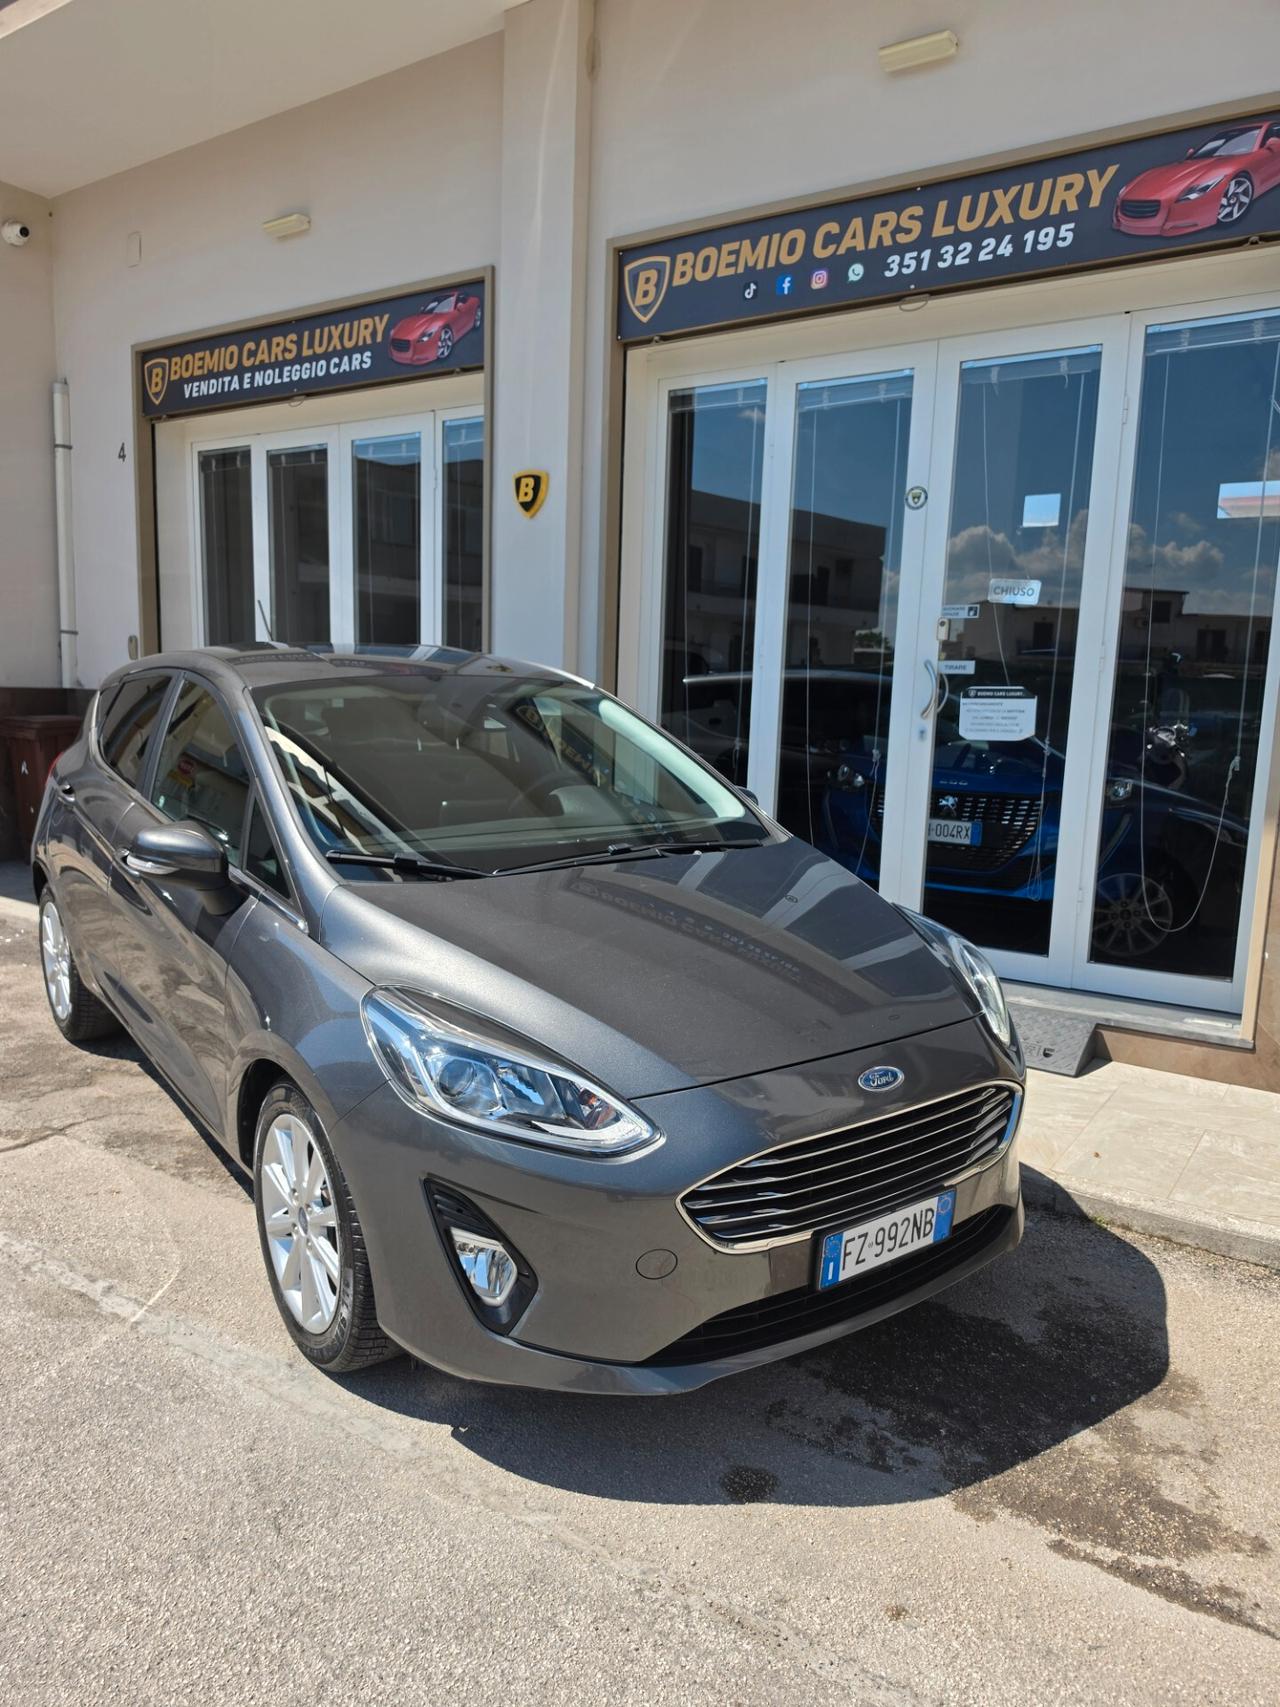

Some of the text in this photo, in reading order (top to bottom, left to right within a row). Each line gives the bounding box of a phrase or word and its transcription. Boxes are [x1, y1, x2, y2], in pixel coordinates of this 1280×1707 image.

[672, 163, 1120, 287] BOEMIO CARS LUXURY
[883, 222, 1075, 278] 351 32 24 195
[634, 268, 659, 307] B
[170, 313, 390, 381] BOEMIO CARS LUXURY
[150, 367, 163, 394] B
[183, 351, 372, 399] VENDITA E NOLEGGIO CARS
[118, 441, 127, 463] 4
[518, 477, 535, 503] B
[993, 585, 1035, 597] CHIUSO
